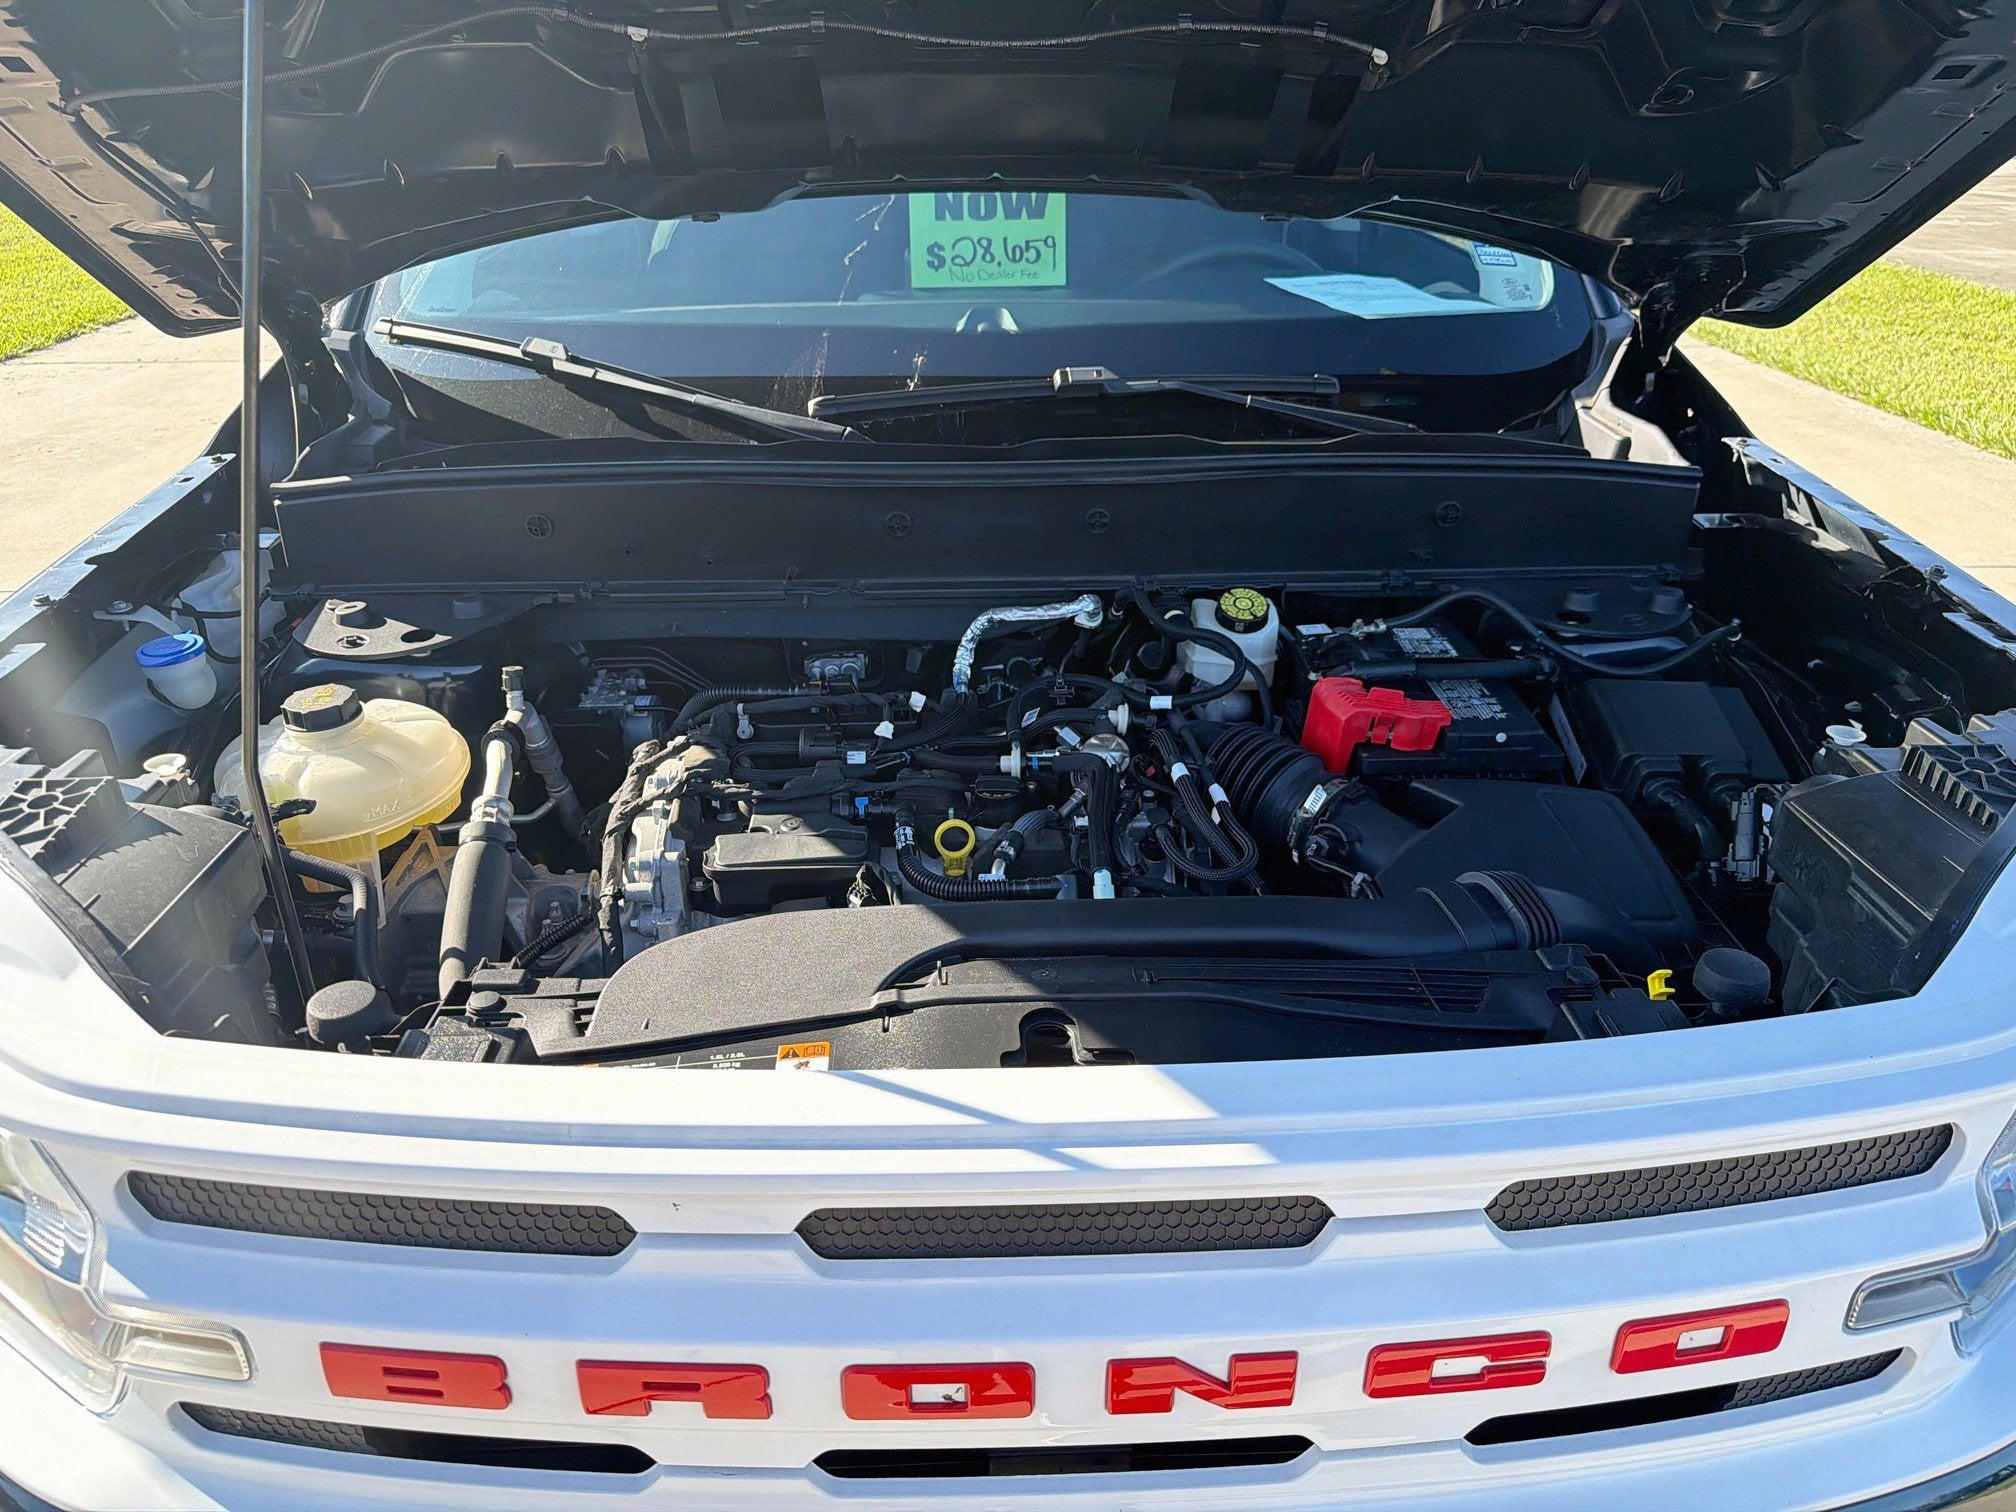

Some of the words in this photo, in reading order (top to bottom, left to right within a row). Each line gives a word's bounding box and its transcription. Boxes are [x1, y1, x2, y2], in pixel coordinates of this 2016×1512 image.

[934, 193, 1049, 222] NOW
[948, 268, 975, 283] No
[977, 269, 1017, 281] Dealer
[1020, 269, 1039, 279] Fee
[371, 798, 401, 817] MAX
[319, 1298, 1790, 1420] BRONCO
